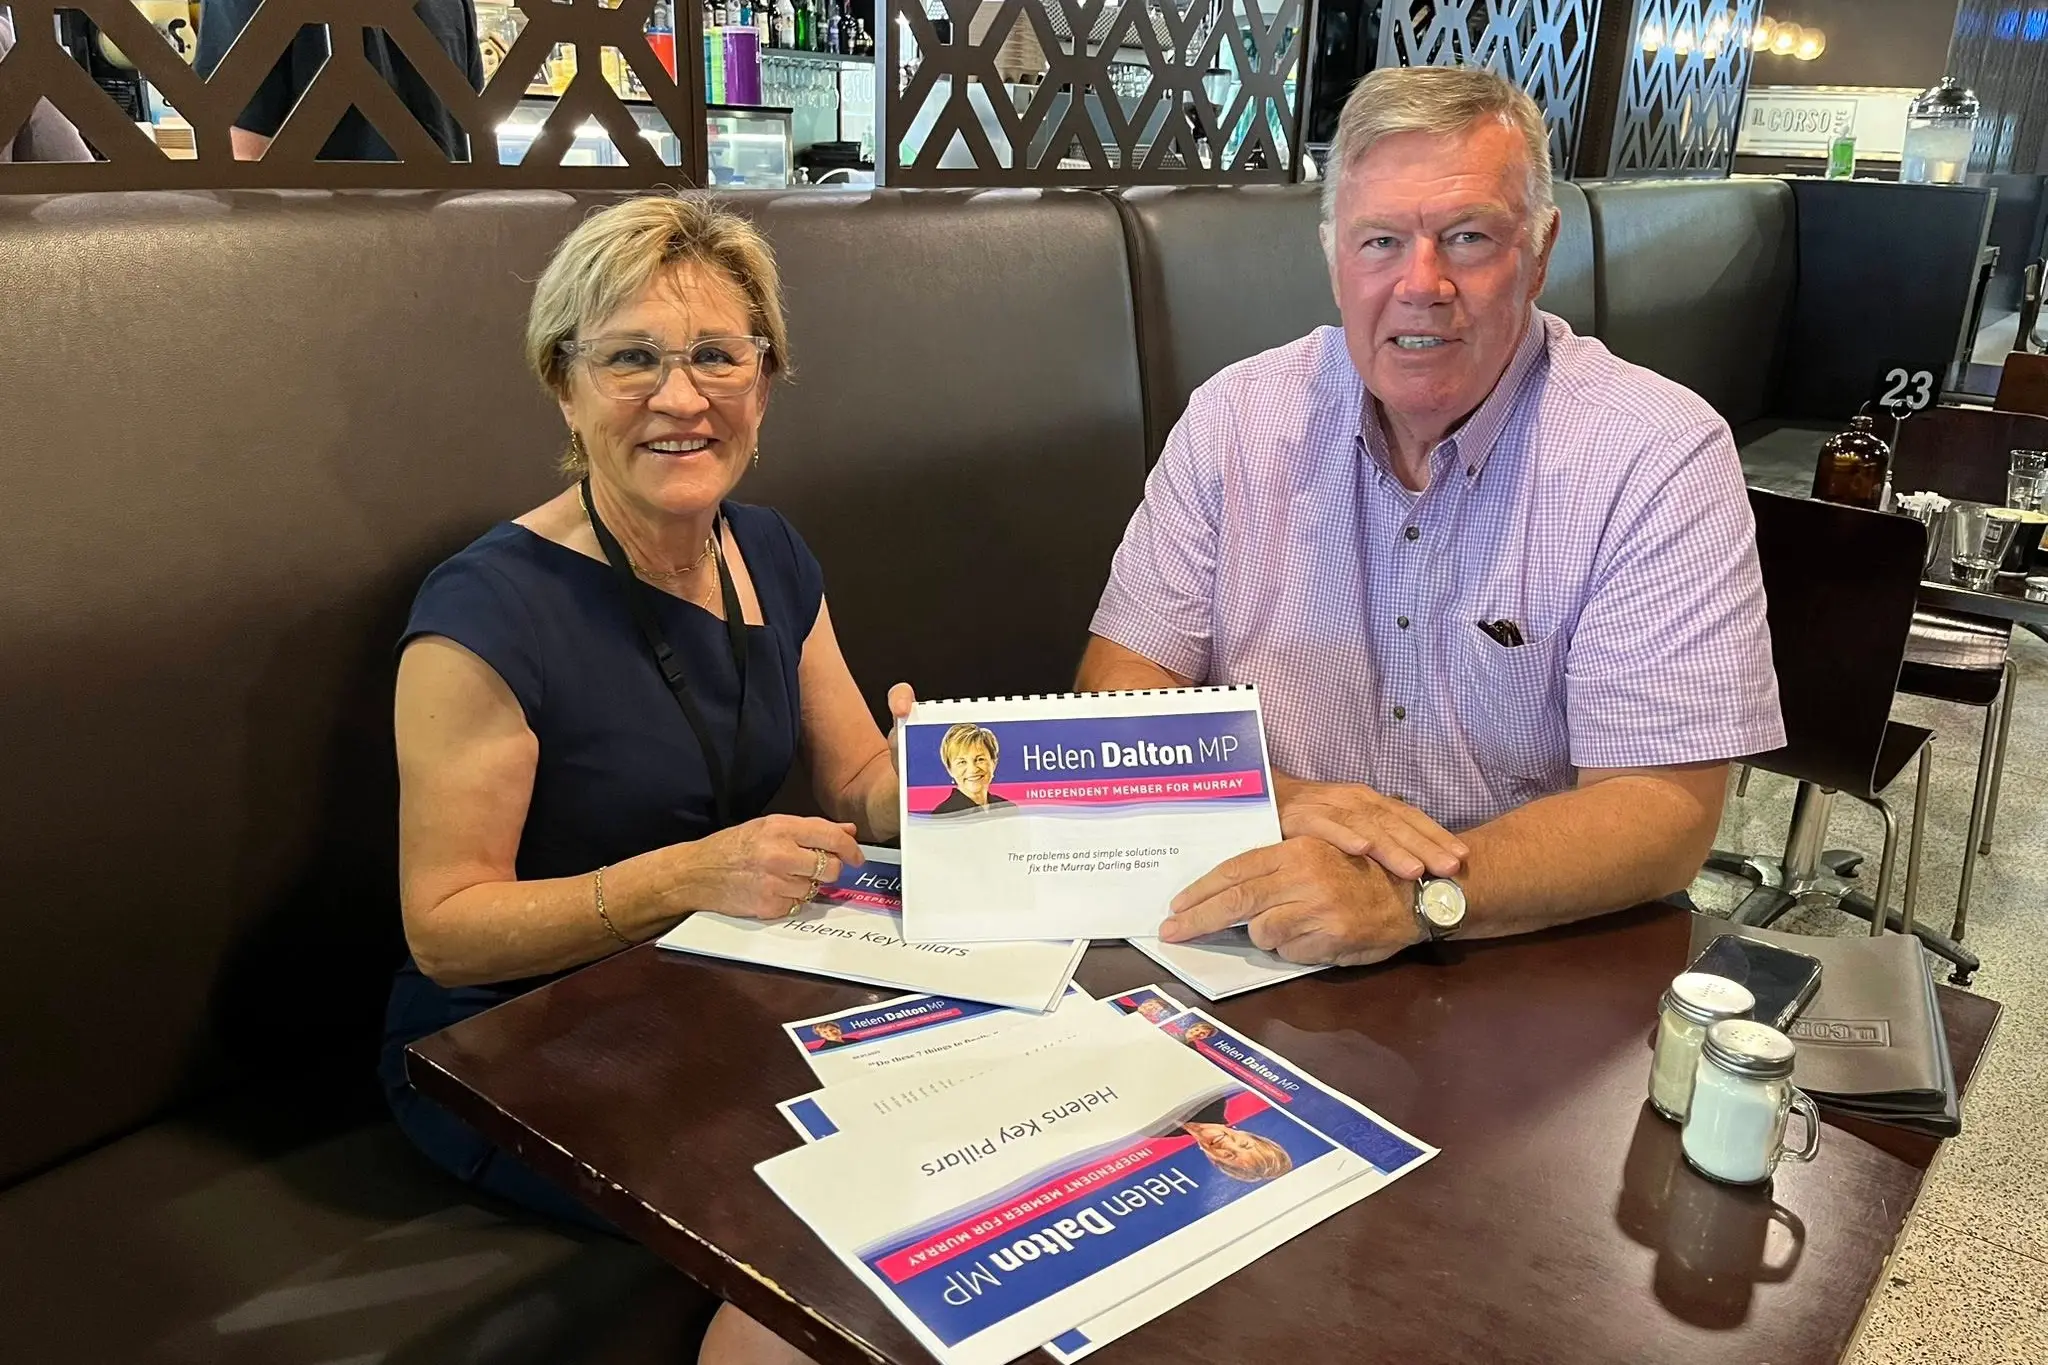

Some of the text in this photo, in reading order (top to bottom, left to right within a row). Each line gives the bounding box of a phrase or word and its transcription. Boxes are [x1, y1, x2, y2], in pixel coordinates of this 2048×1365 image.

[1752, 107, 1831, 133] IL CORSO
[1879, 368, 1933, 410] 23
[1023, 735, 1238, 771] Helen Dalton MP
[1026, 779, 1243, 799] INDEPENDENT MEMBER FOR MURRAY
[1007, 847, 1179, 863] The problems and simple solutions to
[1028, 859, 1159, 875] fix the Murray Darling Basin
[783, 920, 856, 938] Helens
[860, 931, 900, 947] Key
[850, 1016, 886, 1030] Helen
[884, 1004, 928, 1021] Dalton
[927, 1000, 945, 1012] MP
[891, 1054, 914, 1063] these
[924, 1044, 953, 1056] things
[1213, 1040, 1300, 1091] Helen Dalton MP
[921, 1085, 1119, 1177] Helens Key Pillars
[907, 1147, 1154, 1267] INDEPENDENT MEMBER FOR MURRAY
[943, 1167, 1199, 1306] Helen Dalton MP
